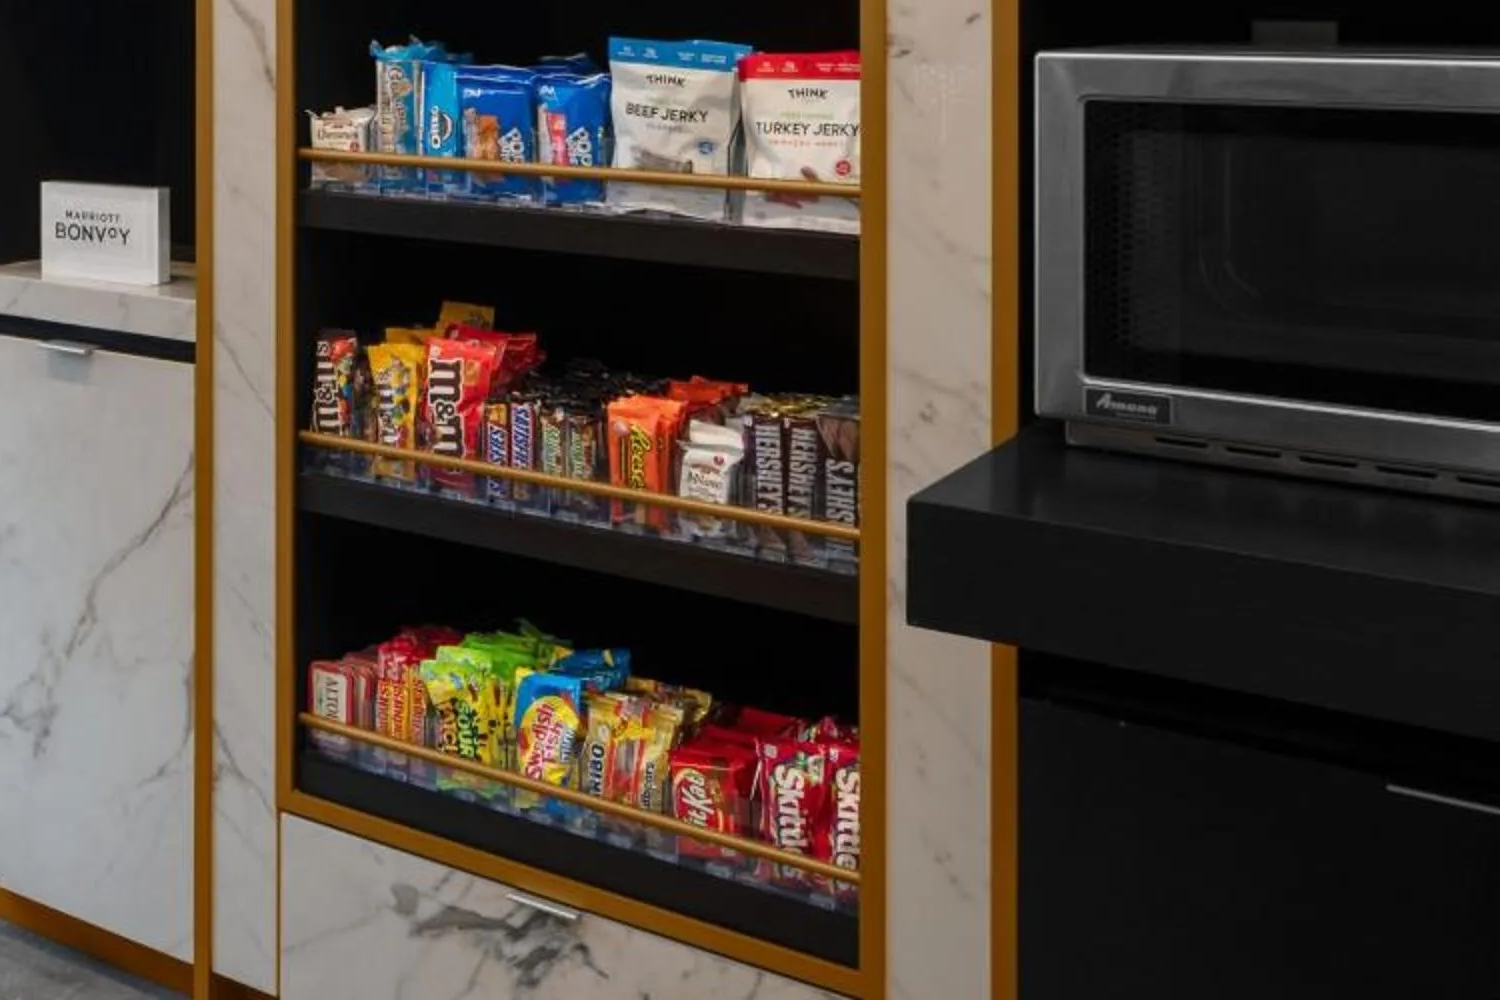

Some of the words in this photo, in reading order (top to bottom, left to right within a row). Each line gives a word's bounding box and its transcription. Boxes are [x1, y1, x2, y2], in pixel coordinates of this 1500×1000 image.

[646, 74, 688, 88] THINK
[787, 87, 829, 101] THINK
[625, 101, 658, 120] BEEF
[660, 105, 709, 124] JERKY
[755, 120, 812, 137] TURKEY
[813, 121, 859, 138] JERKY
[65, 209, 121, 224] MARRIOTT
[55, 221, 130, 246] BONVOY
[825, 458, 856, 523] SHEY'S
[589, 744, 605, 795] RIBO
